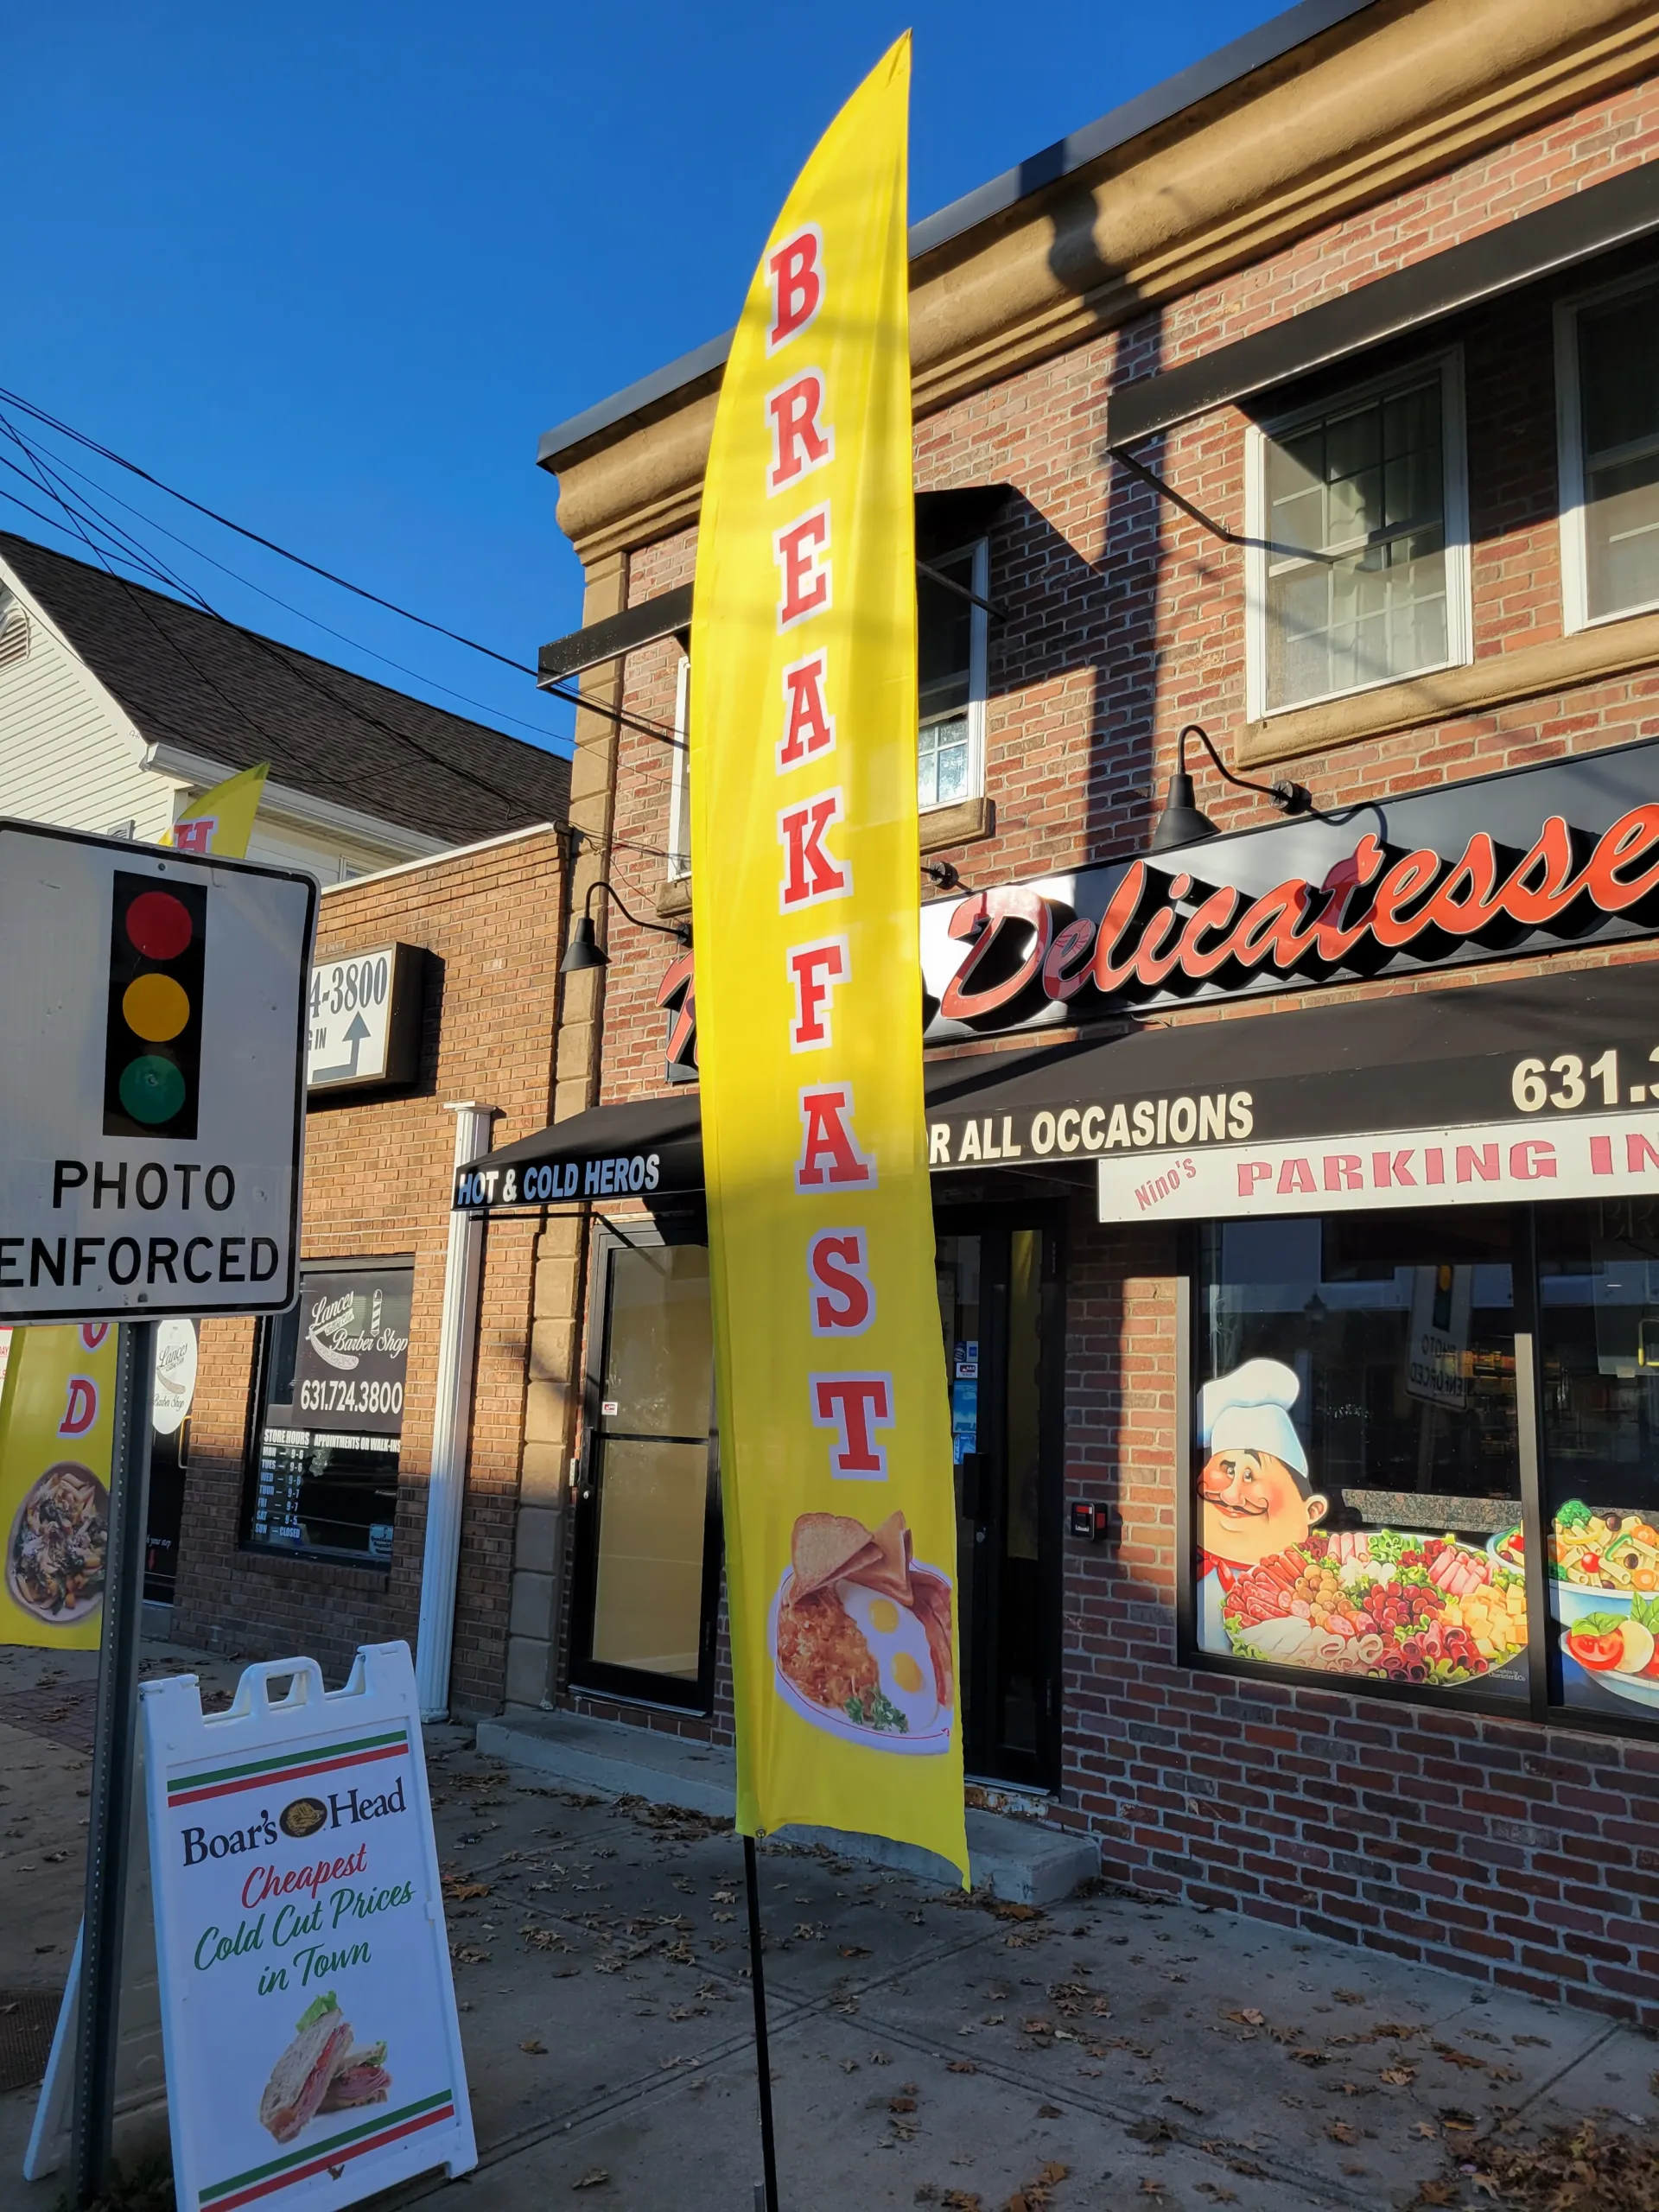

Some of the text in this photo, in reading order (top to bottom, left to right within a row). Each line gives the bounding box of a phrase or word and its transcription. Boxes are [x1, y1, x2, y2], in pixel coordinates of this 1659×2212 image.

[769, 231, 889, 1472] BREAKFAST
[315, 1027, 327, 1050] IN
[959, 1116, 1021, 1162] ALL
[1031, 1091, 1254, 1155] OCCASIONS
[53, 1160, 236, 1211] PHOTO
[457, 1154, 660, 1205] HOT & COLD HEROS
[1135, 1157, 1197, 1211] Nino's
[1236, 1140, 1557, 1197] PARKING
[0, 1236, 279, 1287] ENFORCED
[308, 1290, 355, 1331] Lances
[329, 1327, 409, 1359] Barber Shop
[300, 1379, 404, 1414] 631.724.3800
[262, 1446, 276, 1458] MON
[264, 1428, 310, 1446] STORE HOURS
[314, 1434, 401, 1453] APPOINTMENTS OR WALK-INS
[260, 1471, 274, 1483] WED
[262, 1459, 276, 1470] TUES
[257, 1497, 268, 1508] FRI
[259, 1484, 275, 1496] THUR
[255, 1522, 301, 1539] SUN CLOSED
[256, 1510, 268, 1521] SAT
[181, 1775, 407, 1867] Boar's Head
[241, 1842, 367, 1910] Cheapest
[194, 1879, 416, 1971] Cold Cut Prices
[257, 1941, 372, 1996] in Town
